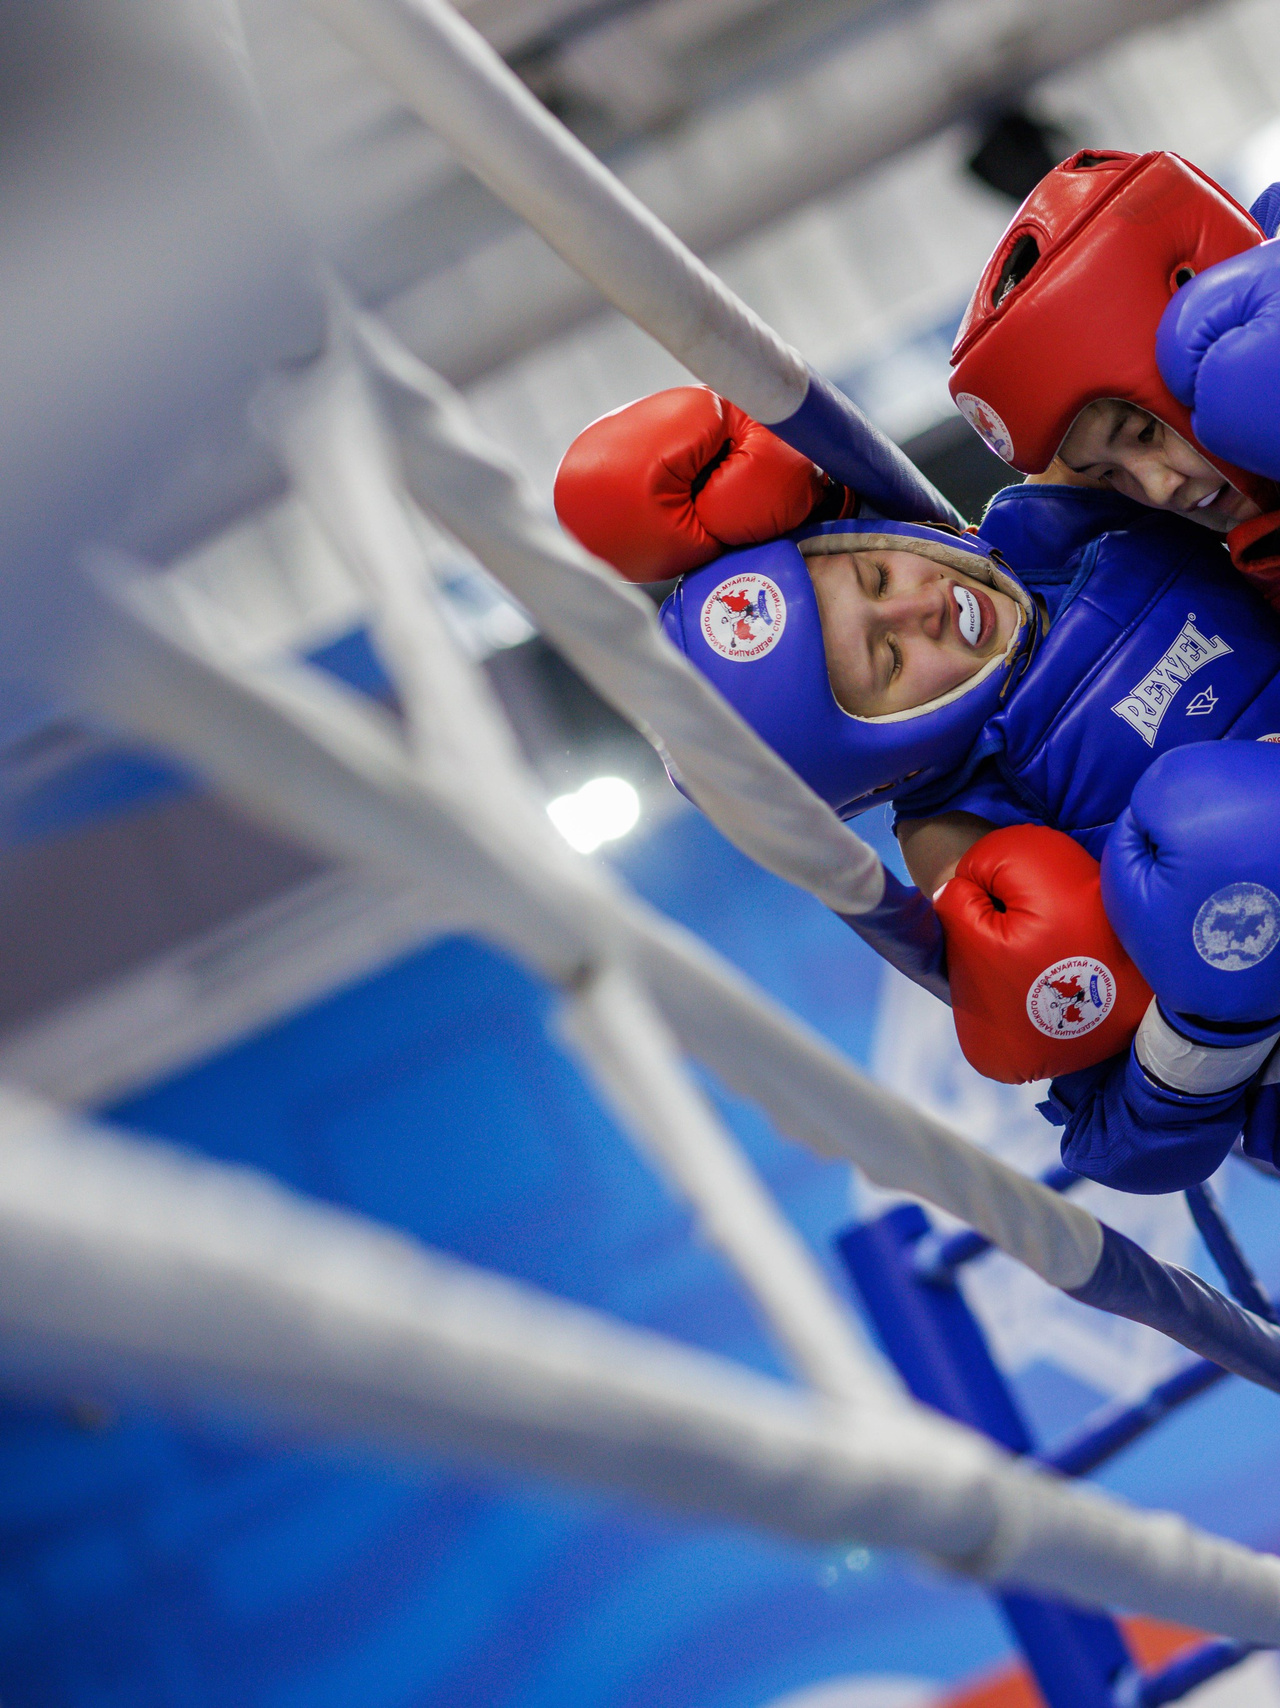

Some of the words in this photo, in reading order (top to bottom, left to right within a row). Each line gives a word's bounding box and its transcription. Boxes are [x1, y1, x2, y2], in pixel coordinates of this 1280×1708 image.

[705, 575, 756, 615] БОКСА-МУАЙТАЙ
[761, 581, 783, 632] СПОРТИВНАЯ
[704, 616, 727, 653] ТАЙСКОГО
[728, 636, 773, 657] ФЕДЕРАЦИЯ
[1110, 619, 1235, 748] REYVEL
[1032, 960, 1088, 998] БОКСА-МУАЙТАЙ
[1091, 980, 1100, 1004] РОССИЯ
[1093, 965, 1113, 1013] СПОРТИВНАЯ
[1031, 1000, 1054, 1033] ТАЙСКОГО
[1055, 1017, 1100, 1036] ФЕДЕРАЦИЯ
